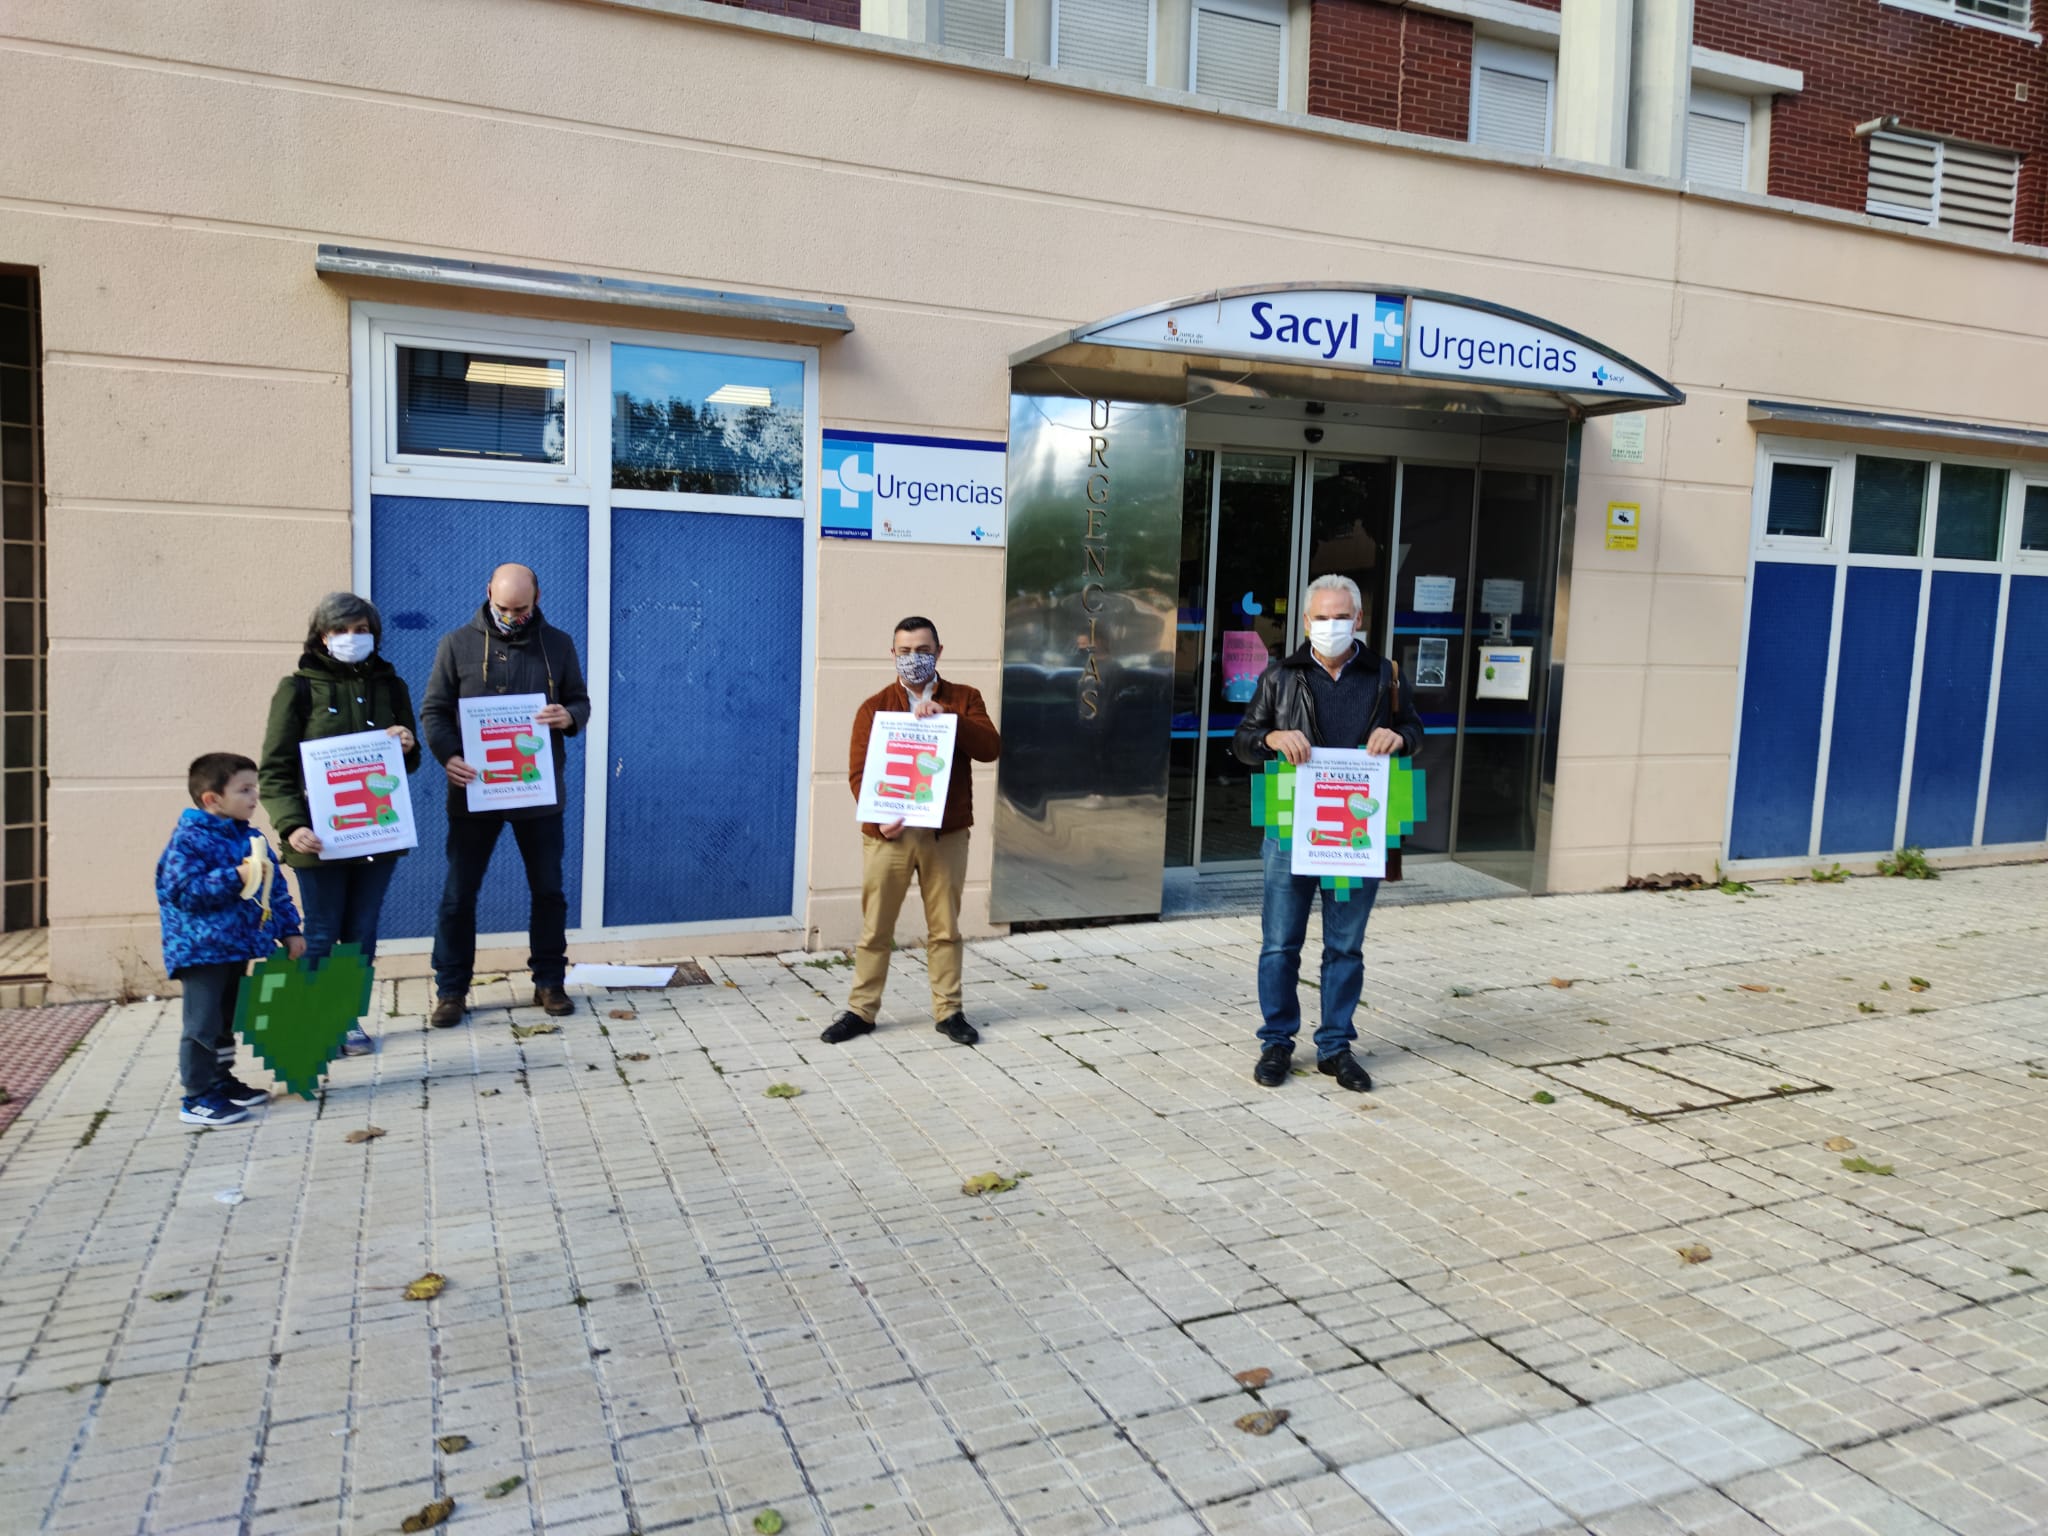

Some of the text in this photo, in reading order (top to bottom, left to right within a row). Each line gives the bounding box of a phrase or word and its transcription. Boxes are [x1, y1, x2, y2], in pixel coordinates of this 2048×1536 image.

[1250, 301, 1359, 360] Sacyl
[1419, 325, 1577, 374] Urgencias
[1609, 374, 1625, 383] Sacyl
[877, 473, 1003, 507] Urgencias
[1078, 399, 1111, 720] URGENCIAS
[480, 716, 531, 725] REVUELTA
[888, 732, 939, 740] REVUELTA
[325, 753, 384, 768] REVUELTA
[1315, 772, 1370, 780] REVUELTA
[334, 831, 370, 843] BURGOS
[1308, 850, 1370, 860] BURGOS RURAL
